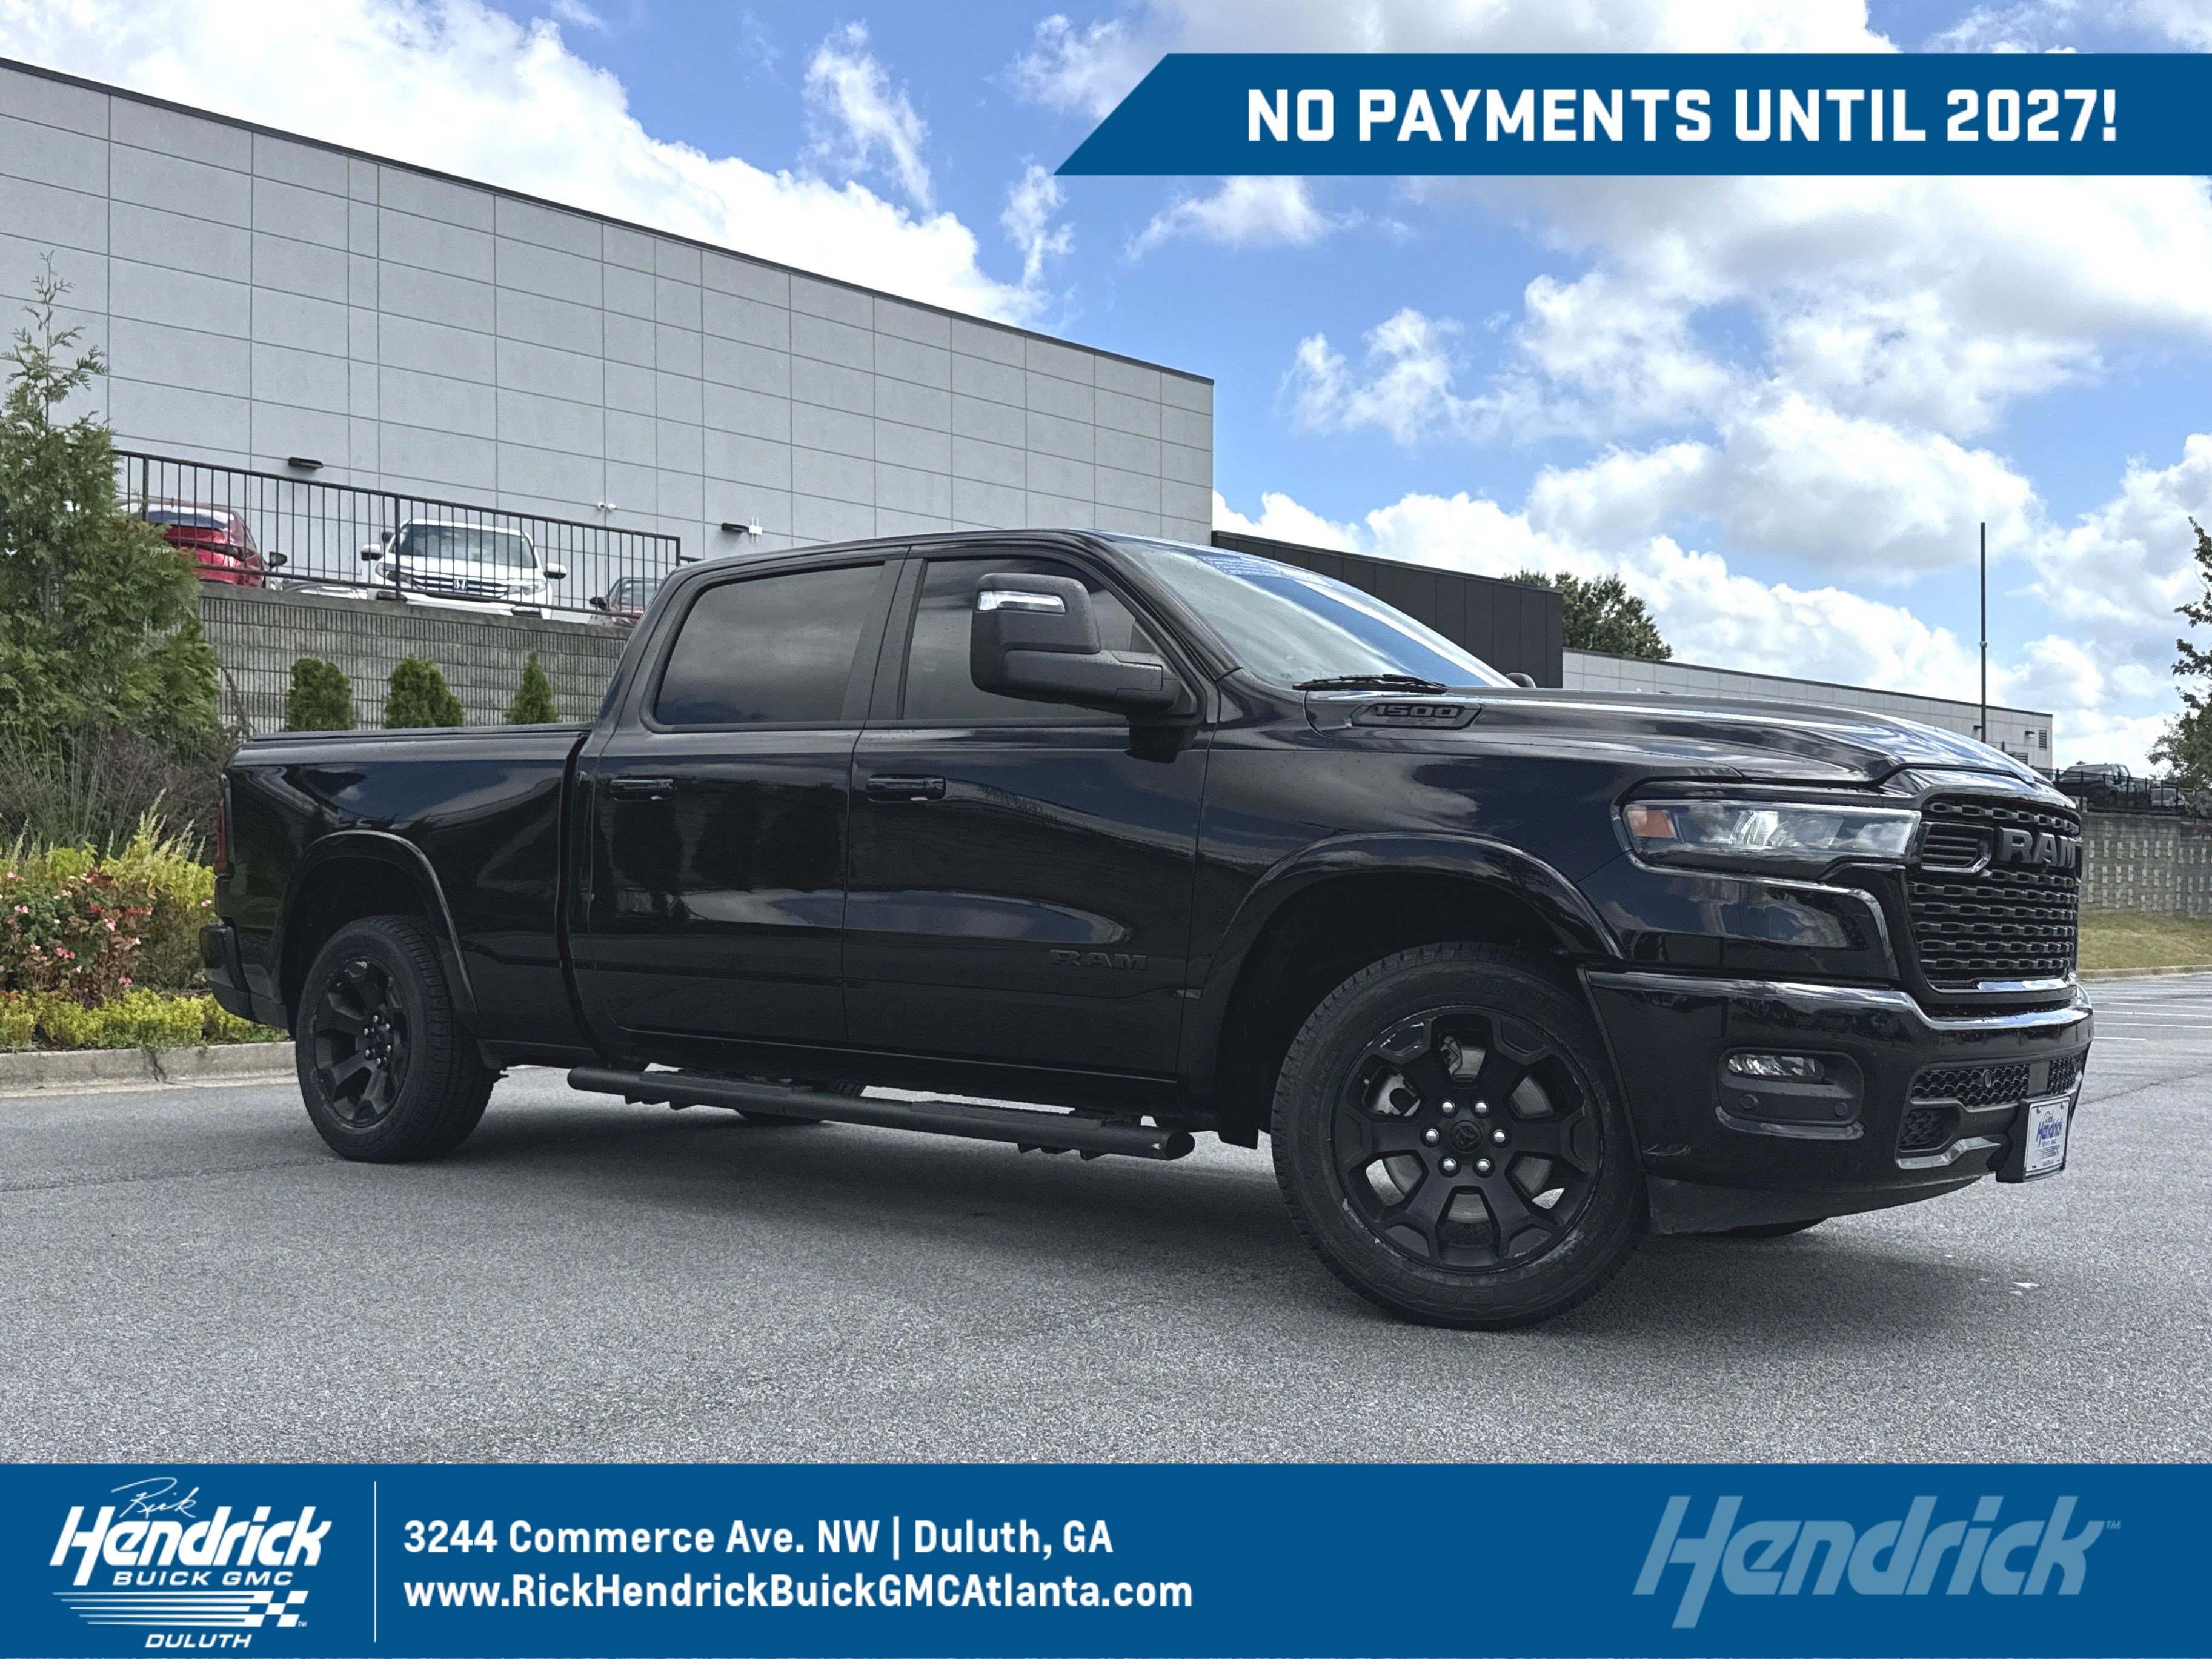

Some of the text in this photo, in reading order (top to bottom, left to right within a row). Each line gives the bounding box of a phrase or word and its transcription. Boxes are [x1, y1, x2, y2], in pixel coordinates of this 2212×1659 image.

[1373, 705, 1459, 718] 1500
[1998, 826, 2077, 869] RAM
[1049, 949, 1148, 971] RAM
